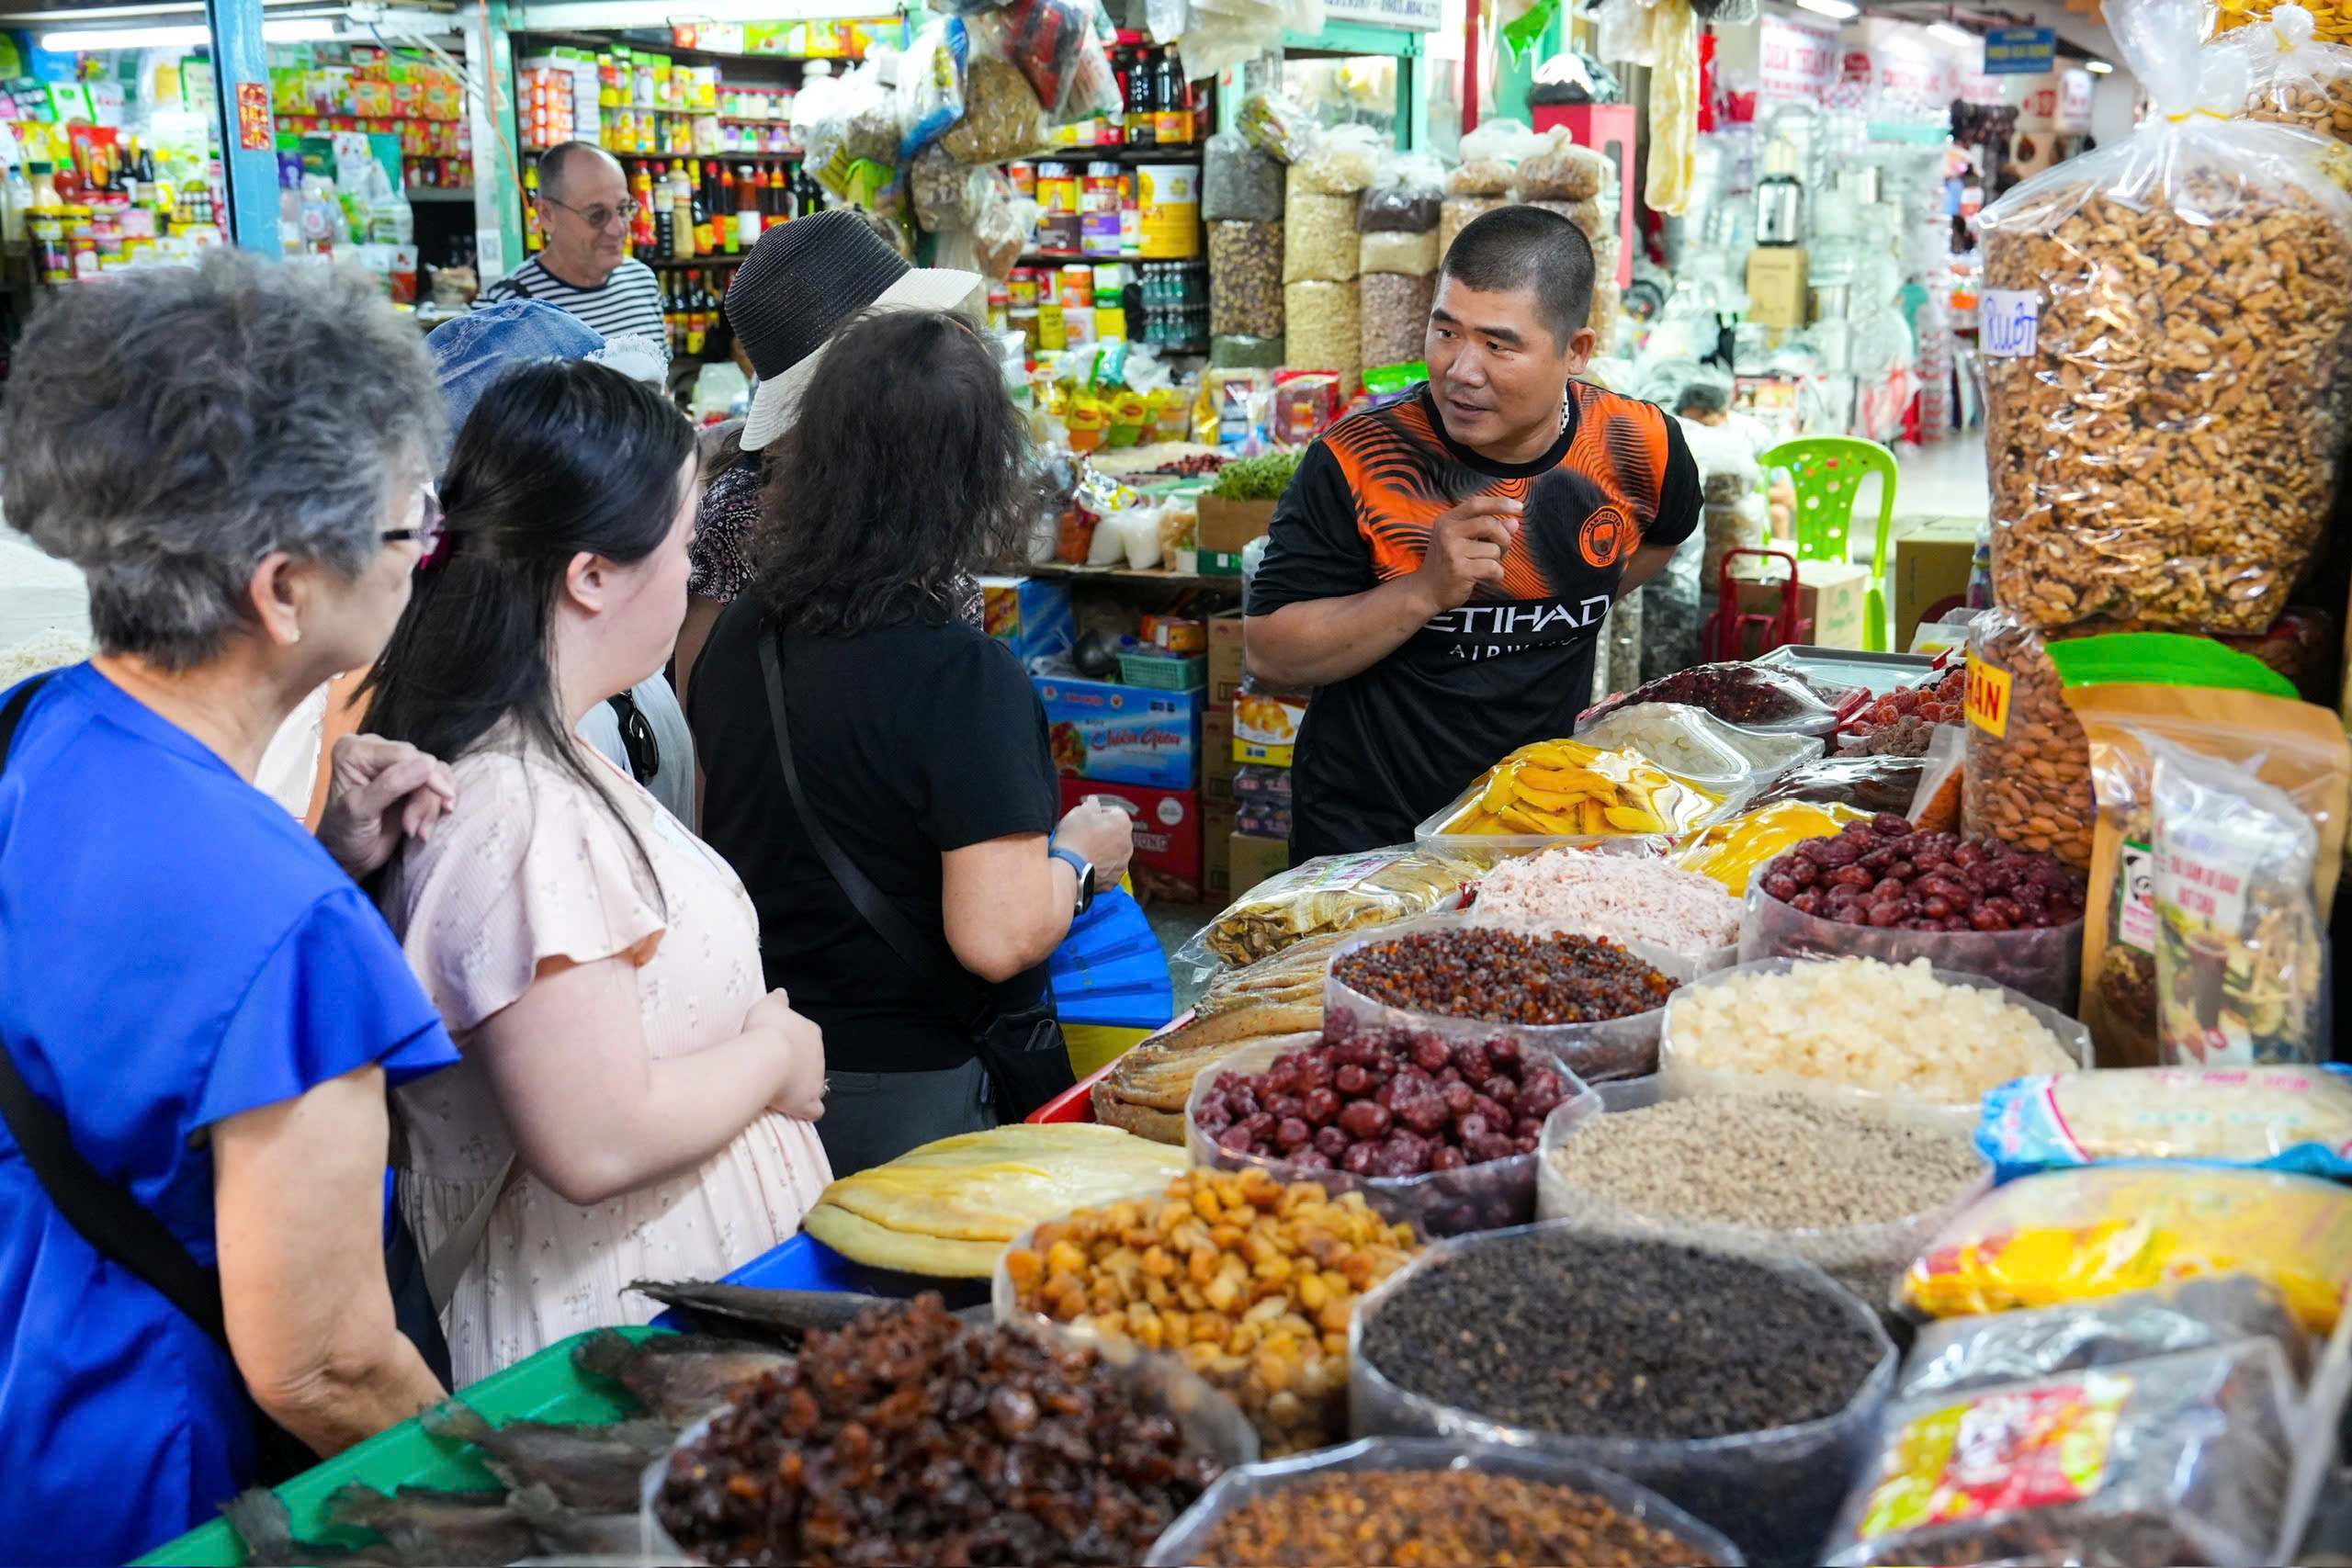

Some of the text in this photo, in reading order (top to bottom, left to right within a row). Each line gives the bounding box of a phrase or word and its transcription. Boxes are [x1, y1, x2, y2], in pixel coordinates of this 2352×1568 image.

[1586, 512, 1622, 534] MANCHESTER
[1598, 555, 1611, 564] CITY
[1423, 594, 1610, 634] ETIHAD
